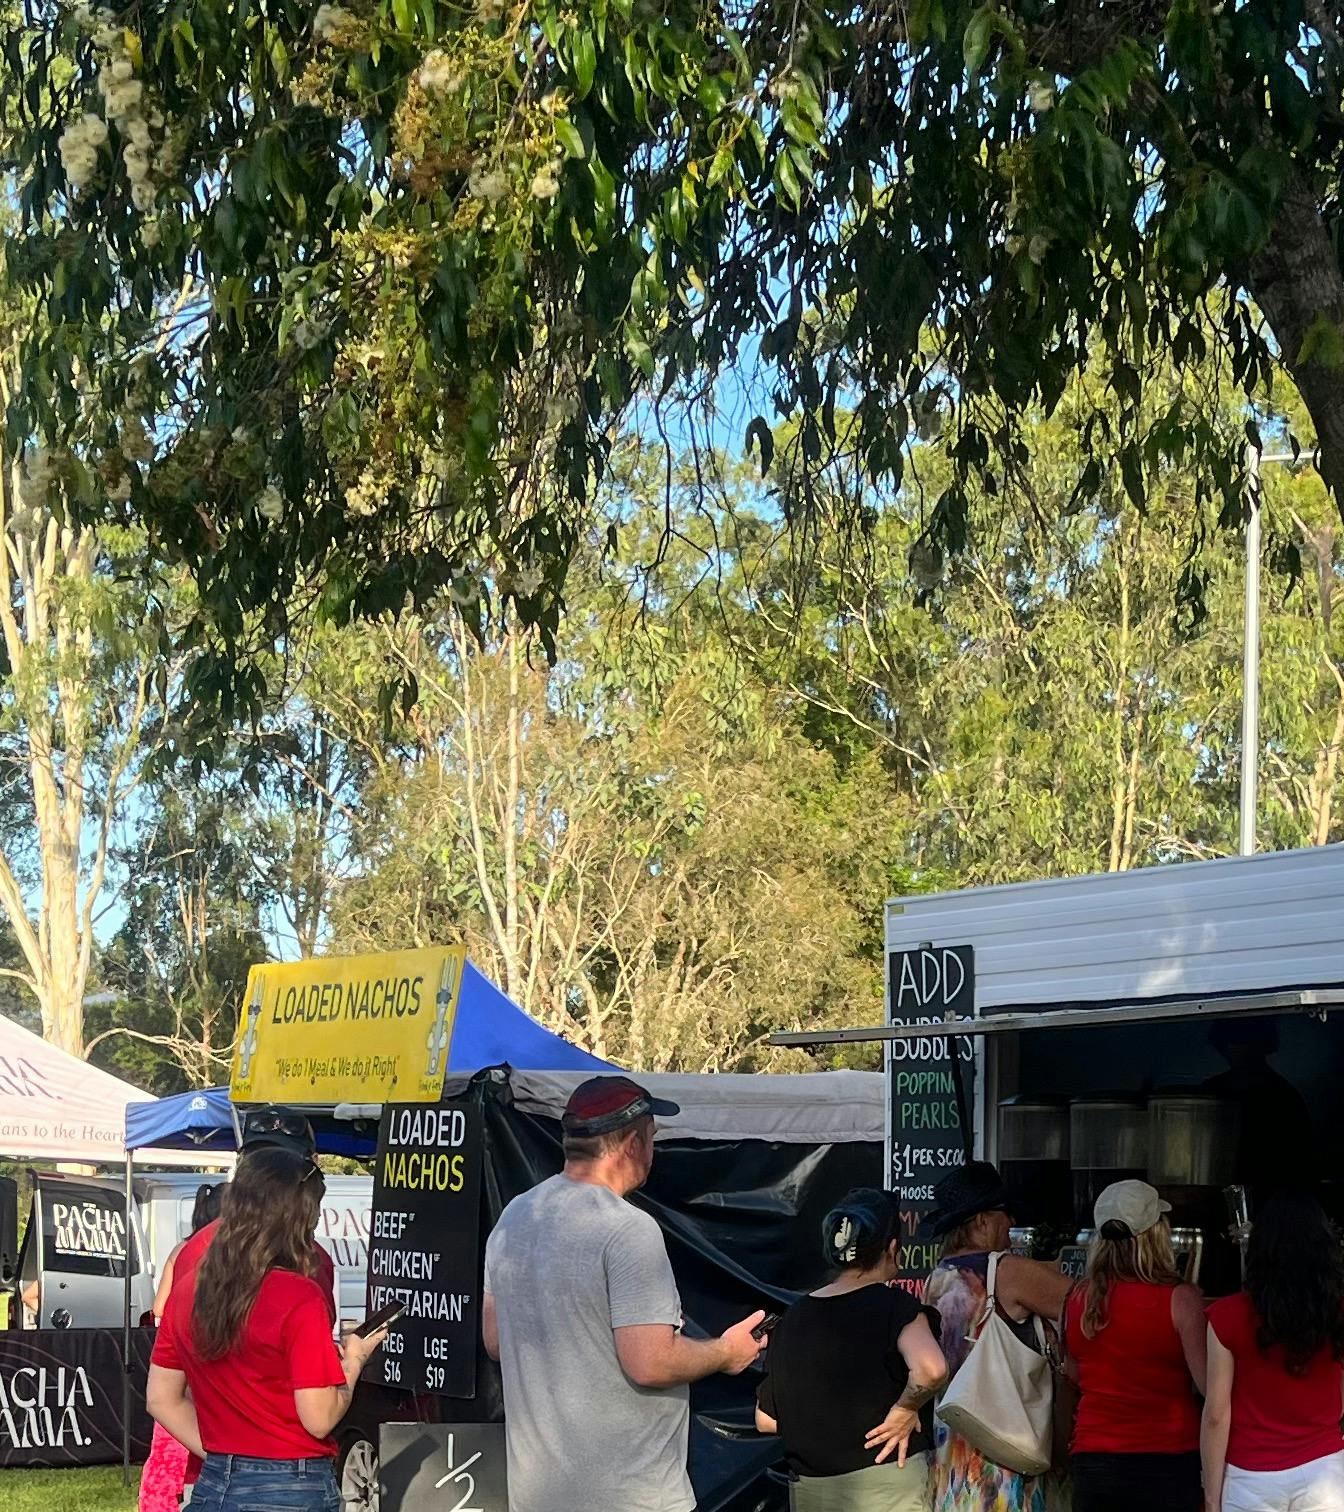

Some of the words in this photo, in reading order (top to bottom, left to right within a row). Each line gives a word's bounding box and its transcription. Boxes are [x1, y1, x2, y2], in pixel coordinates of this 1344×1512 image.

[897, 950, 965, 1007] ADD
[272, 983, 343, 1024] LOADED
[344, 976, 424, 1020] NACHOS
[896, 1071, 956, 1096] POPPIN
[388, 1109, 466, 1147] LOADED
[901, 1100, 961, 1129] PEARLS
[34, 1122, 49, 1137] to
[54, 1122, 77, 1140] the
[80, 1125, 126, 1144] Heart
[383, 1152, 465, 1192] NACHOS
[912, 1149, 935, 1167] PER
[53, 1203, 126, 1235] PACHA
[374, 1211, 408, 1240] BEEF
[371, 1248, 434, 1281] CHICKEN
[382, 1332, 404, 1354] REG
[423, 1336, 448, 1360] LGE
[384, 1358, 402, 1382] $16
[425, 1364, 445, 1389] $19
